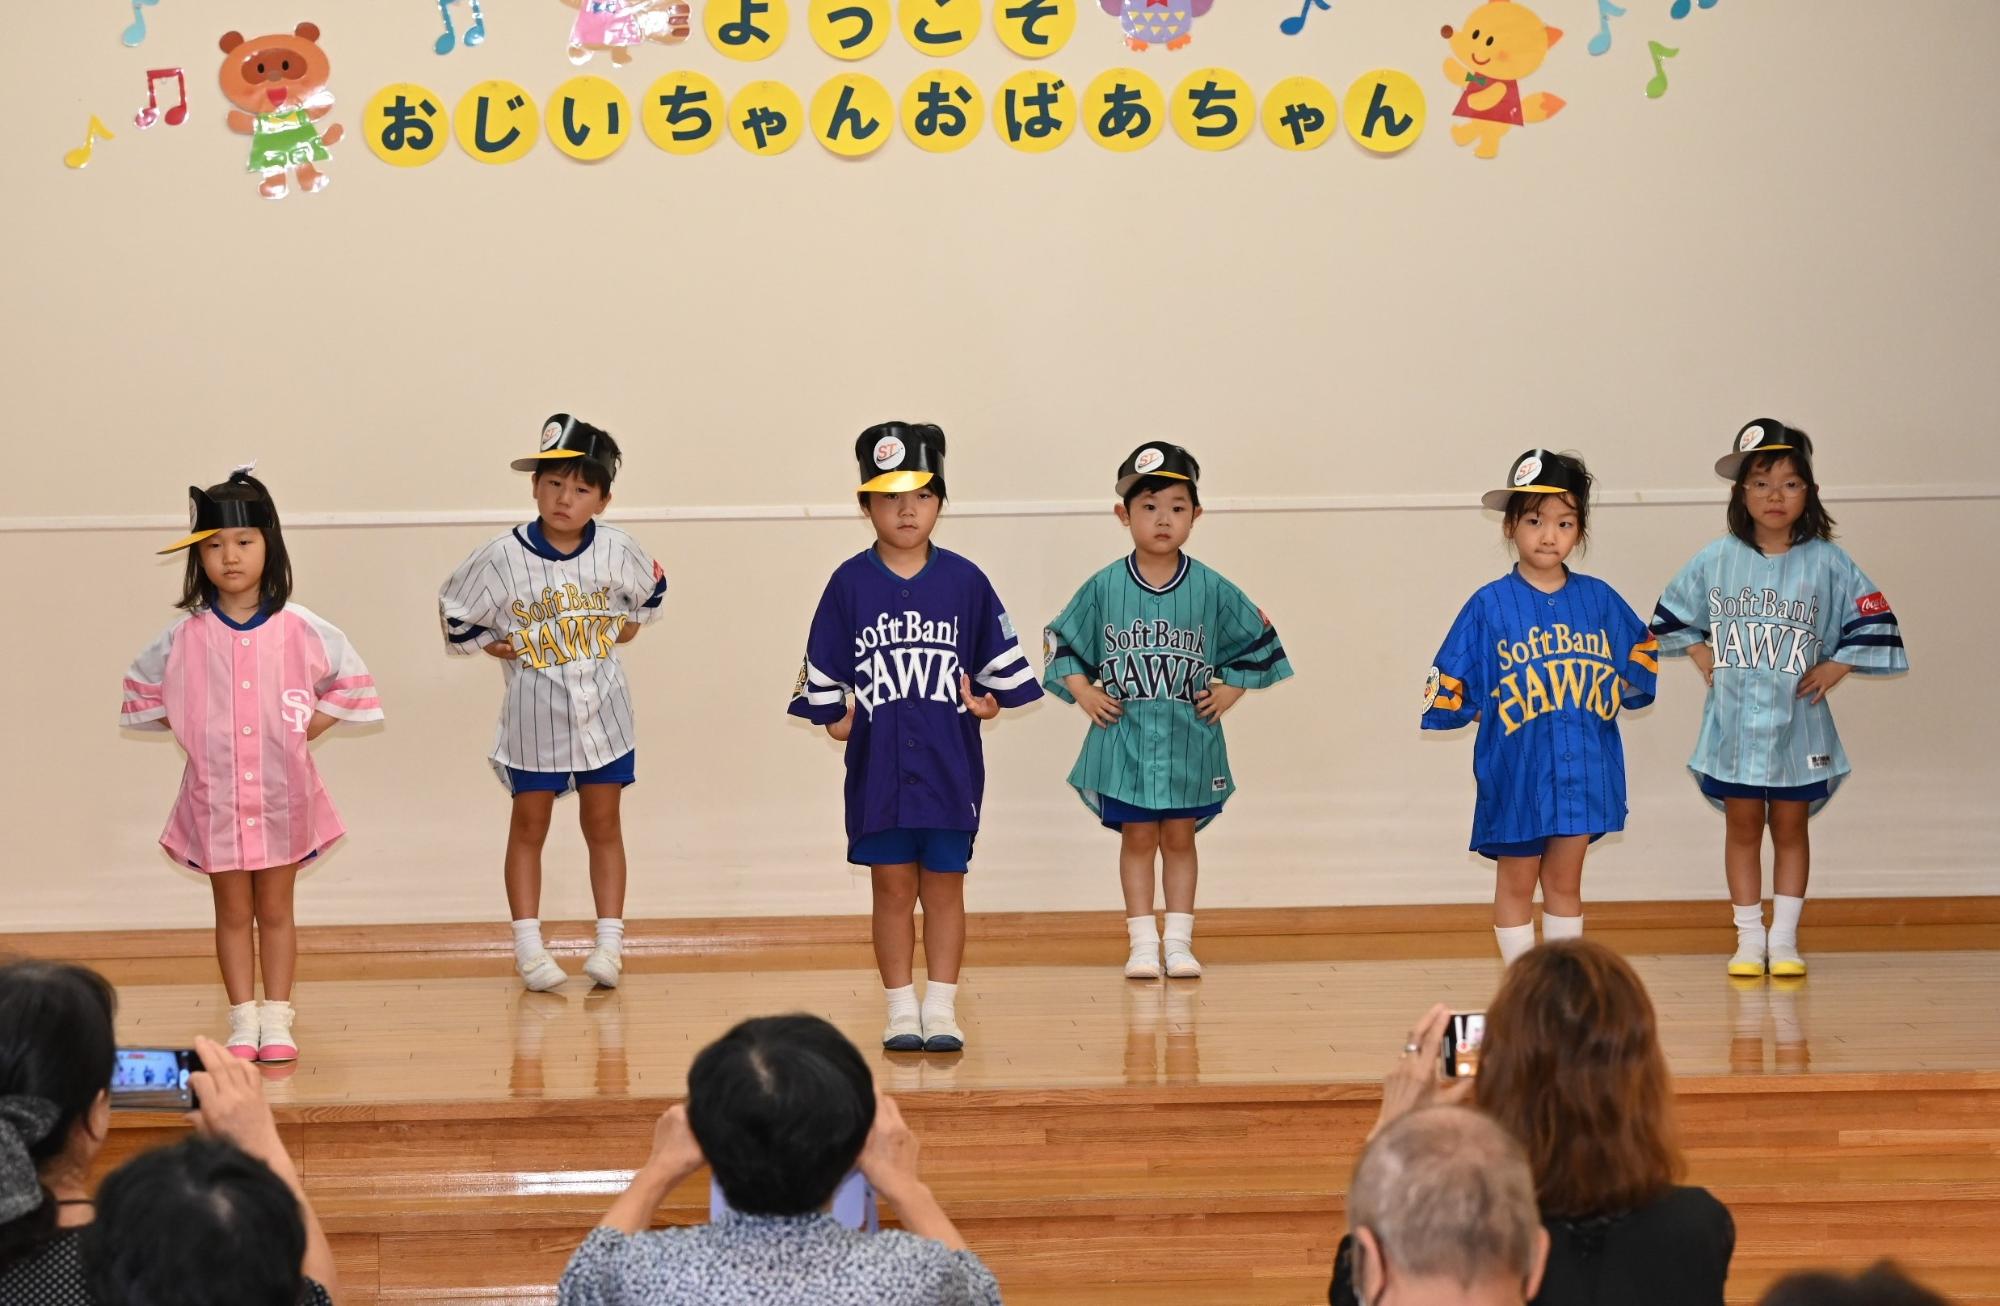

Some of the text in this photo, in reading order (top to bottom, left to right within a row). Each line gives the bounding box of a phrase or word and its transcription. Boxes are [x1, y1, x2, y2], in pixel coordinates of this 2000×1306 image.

[381, 80, 1414, 153] おじいちゃんおばあちゃん
[878, 443, 897, 458] ST
[512, 583, 610, 628] SoftBan
[1708, 587, 1819, 628] SoftBank
[504, 612, 629, 669] HAWK
[855, 647, 968, 722] HAWK
